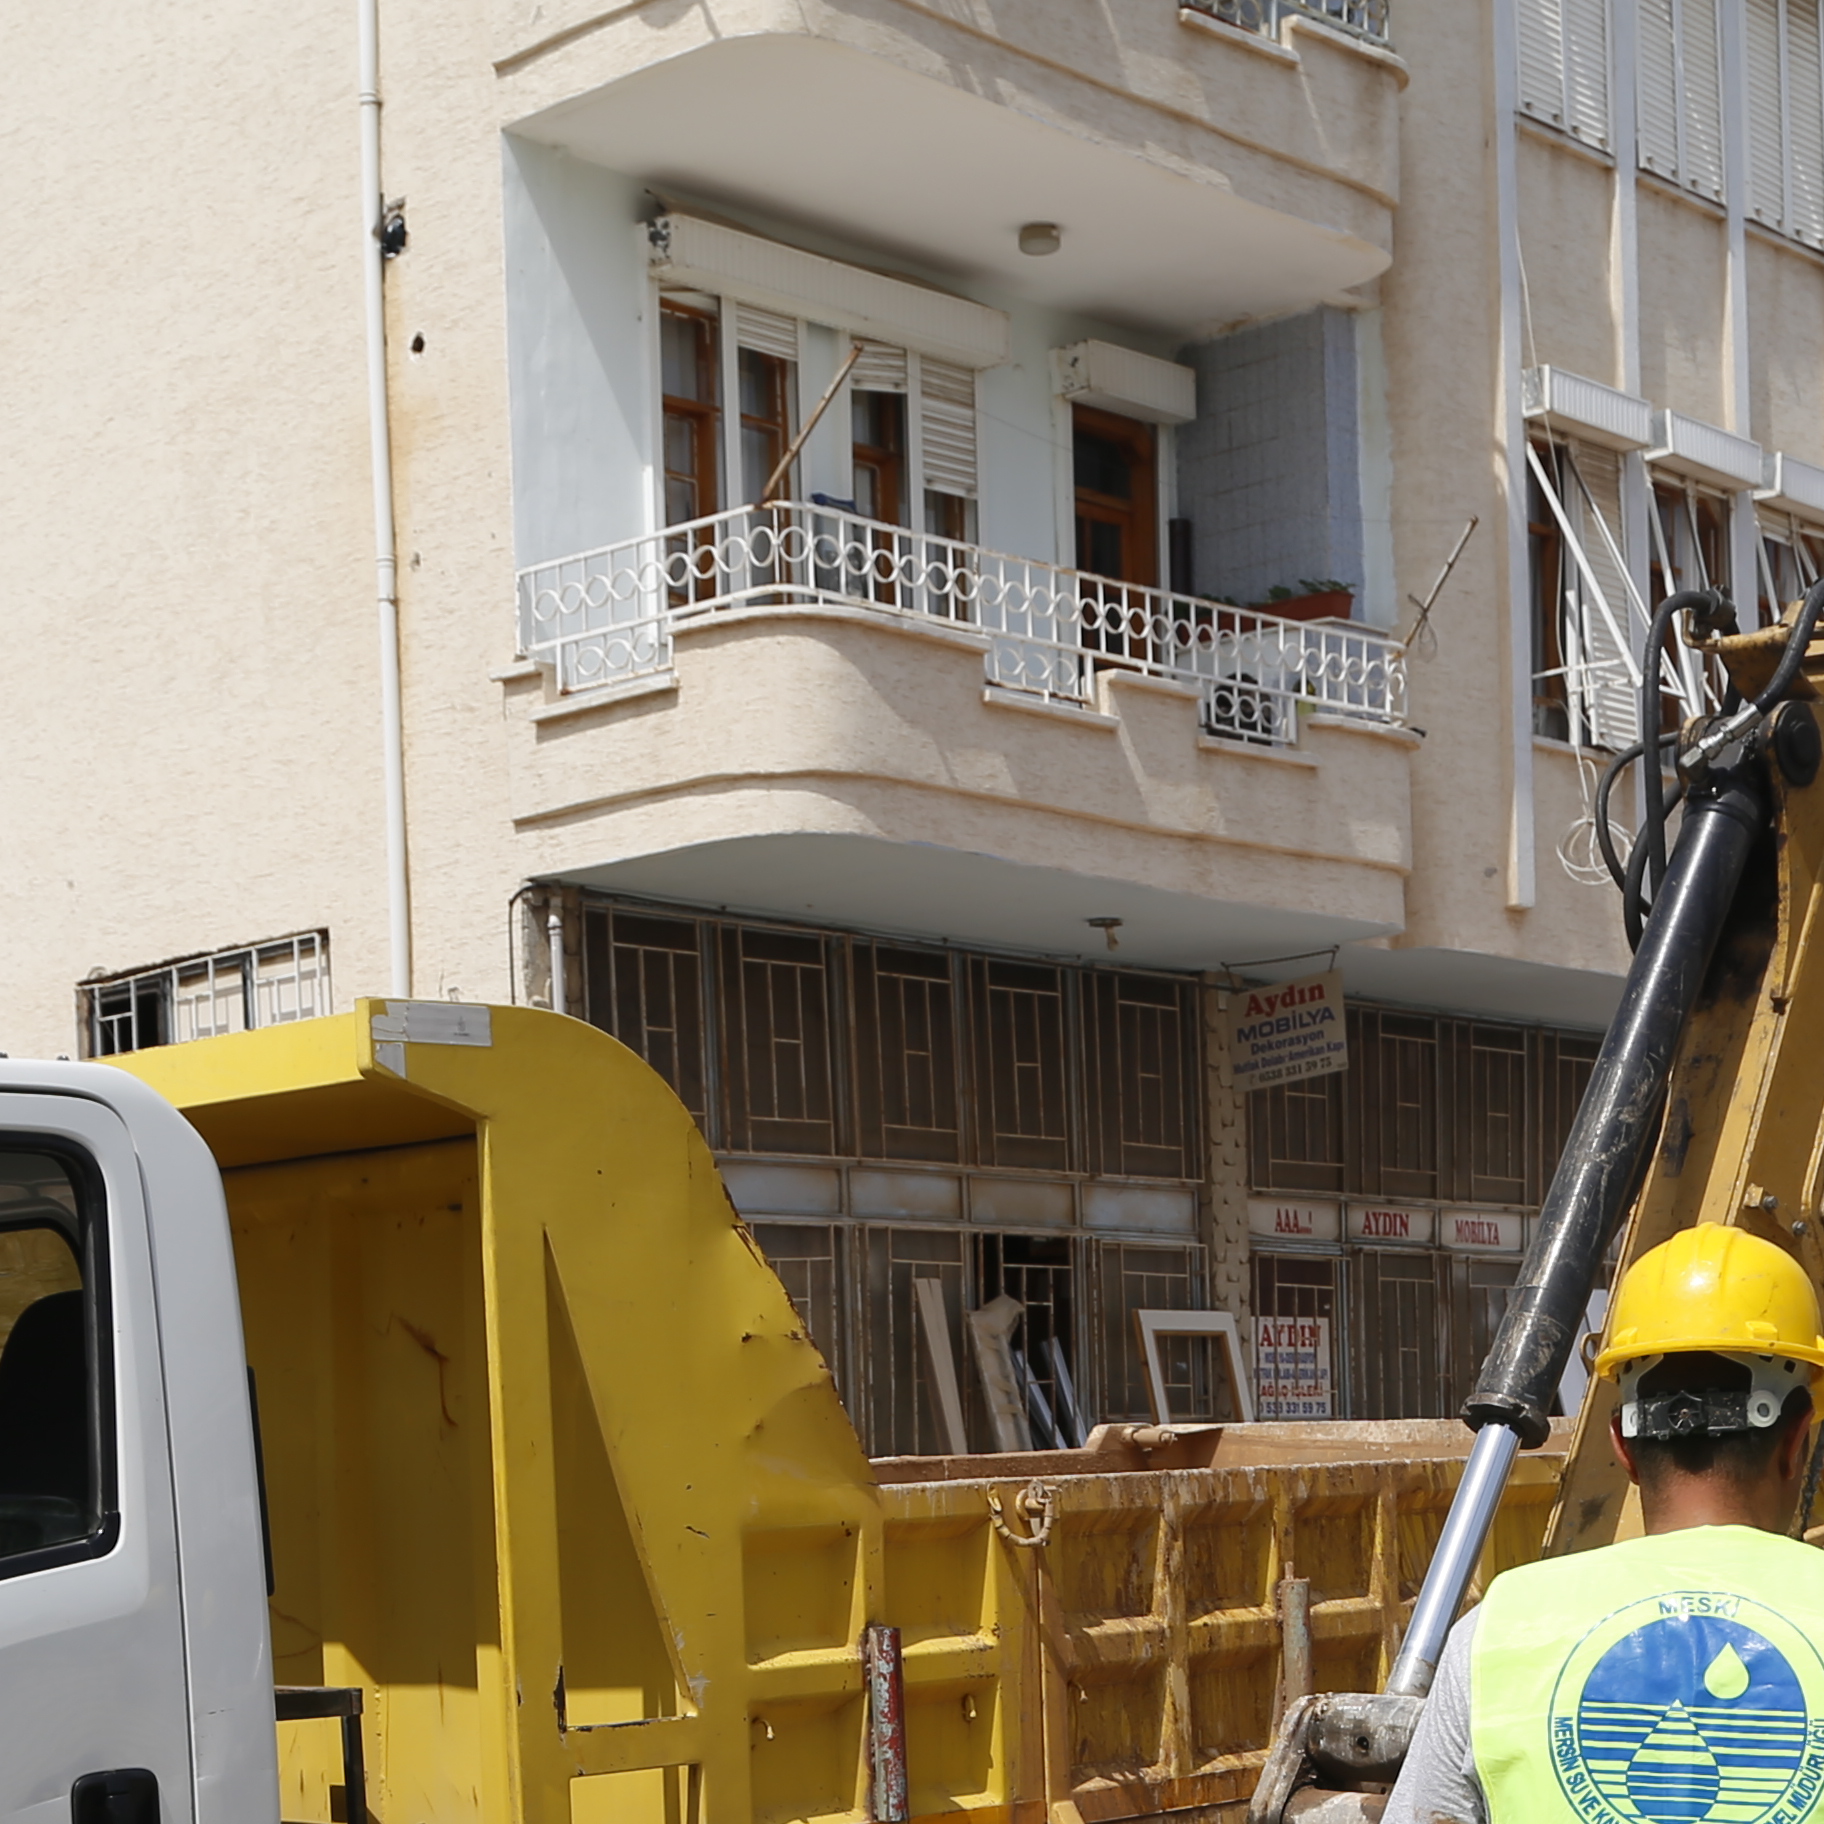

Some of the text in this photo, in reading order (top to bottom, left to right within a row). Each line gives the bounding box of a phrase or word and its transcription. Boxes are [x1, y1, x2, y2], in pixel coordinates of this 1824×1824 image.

[1245, 983, 1326, 1018] Aydın
[1236, 1006, 1336, 1043] MOBİLYA
[1251, 1030, 1325, 1056] Dekorasyon
[1320, 1056, 1333, 1069] 75
[1361, 1210, 1411, 1238] AYDIN
[1454, 1213, 1501, 1246] MOBİLYA
[1260, 1323, 1322, 1347] AYDIN
[1261, 1380, 1289, 1400] AĞÇ
[1302, 1401, 1314, 1415] 59
[1316, 1401, 1327, 1414] 75
[1554, 1716, 1582, 1773] MERSİN
[1565, 1773, 1585, 1793] SU
[1577, 1790, 1598, 1816] VE
